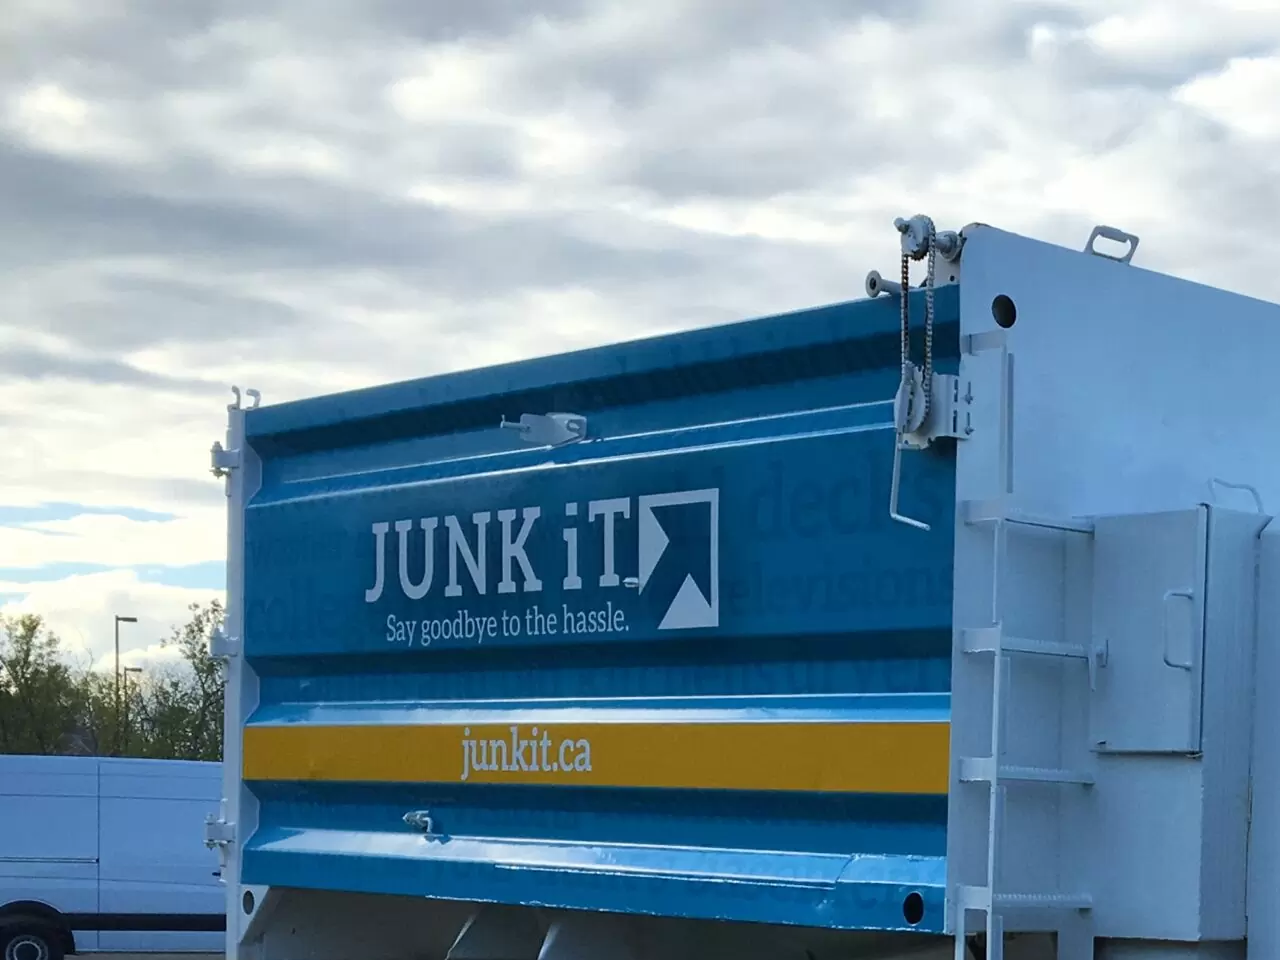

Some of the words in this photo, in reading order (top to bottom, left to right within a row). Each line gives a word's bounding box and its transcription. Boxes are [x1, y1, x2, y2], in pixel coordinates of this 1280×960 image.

[365, 506, 542, 602] JUNK
[386, 614, 416, 647] Say
[421, 610, 497, 647] goodbye
[502, 617, 520, 636] to
[526, 605, 557, 635] the
[562, 602, 629, 634] hassle.
[461, 726, 592, 780] junkit.ca
